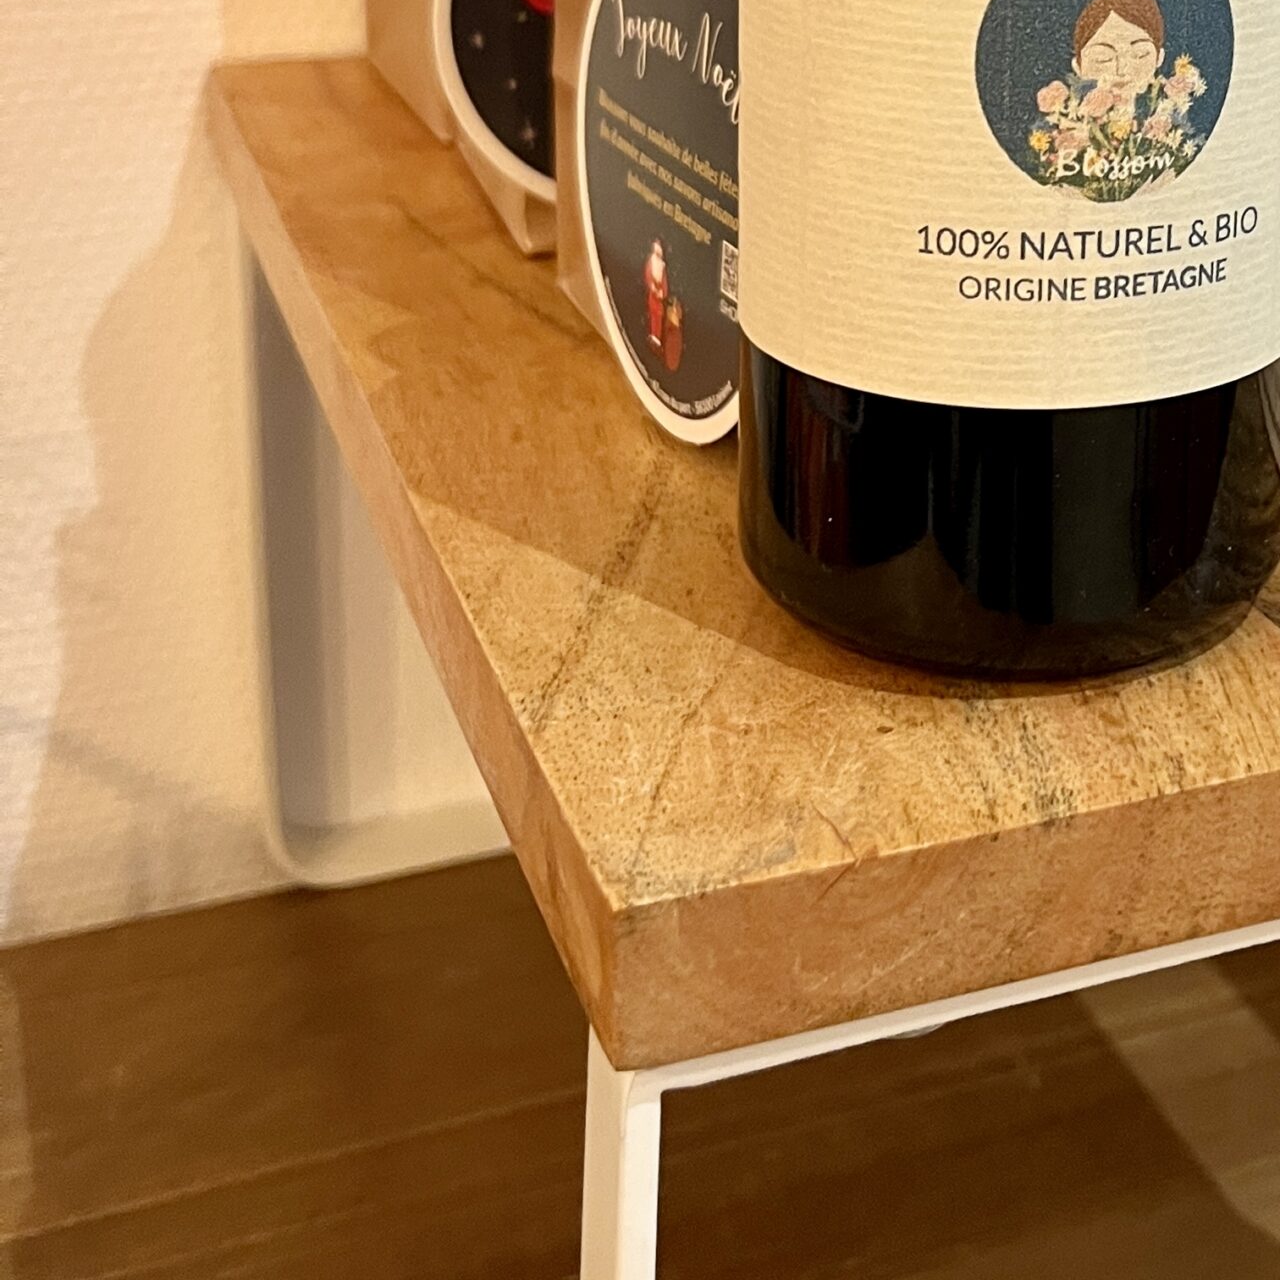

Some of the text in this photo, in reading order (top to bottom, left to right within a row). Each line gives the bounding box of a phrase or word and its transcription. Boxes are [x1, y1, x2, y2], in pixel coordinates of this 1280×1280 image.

[1056, 148, 1175, 180] Blossom
[917, 206, 1258, 260] 100% NATUREL & BIO
[959, 257, 1228, 302] ORIGINE BRETAGNE
